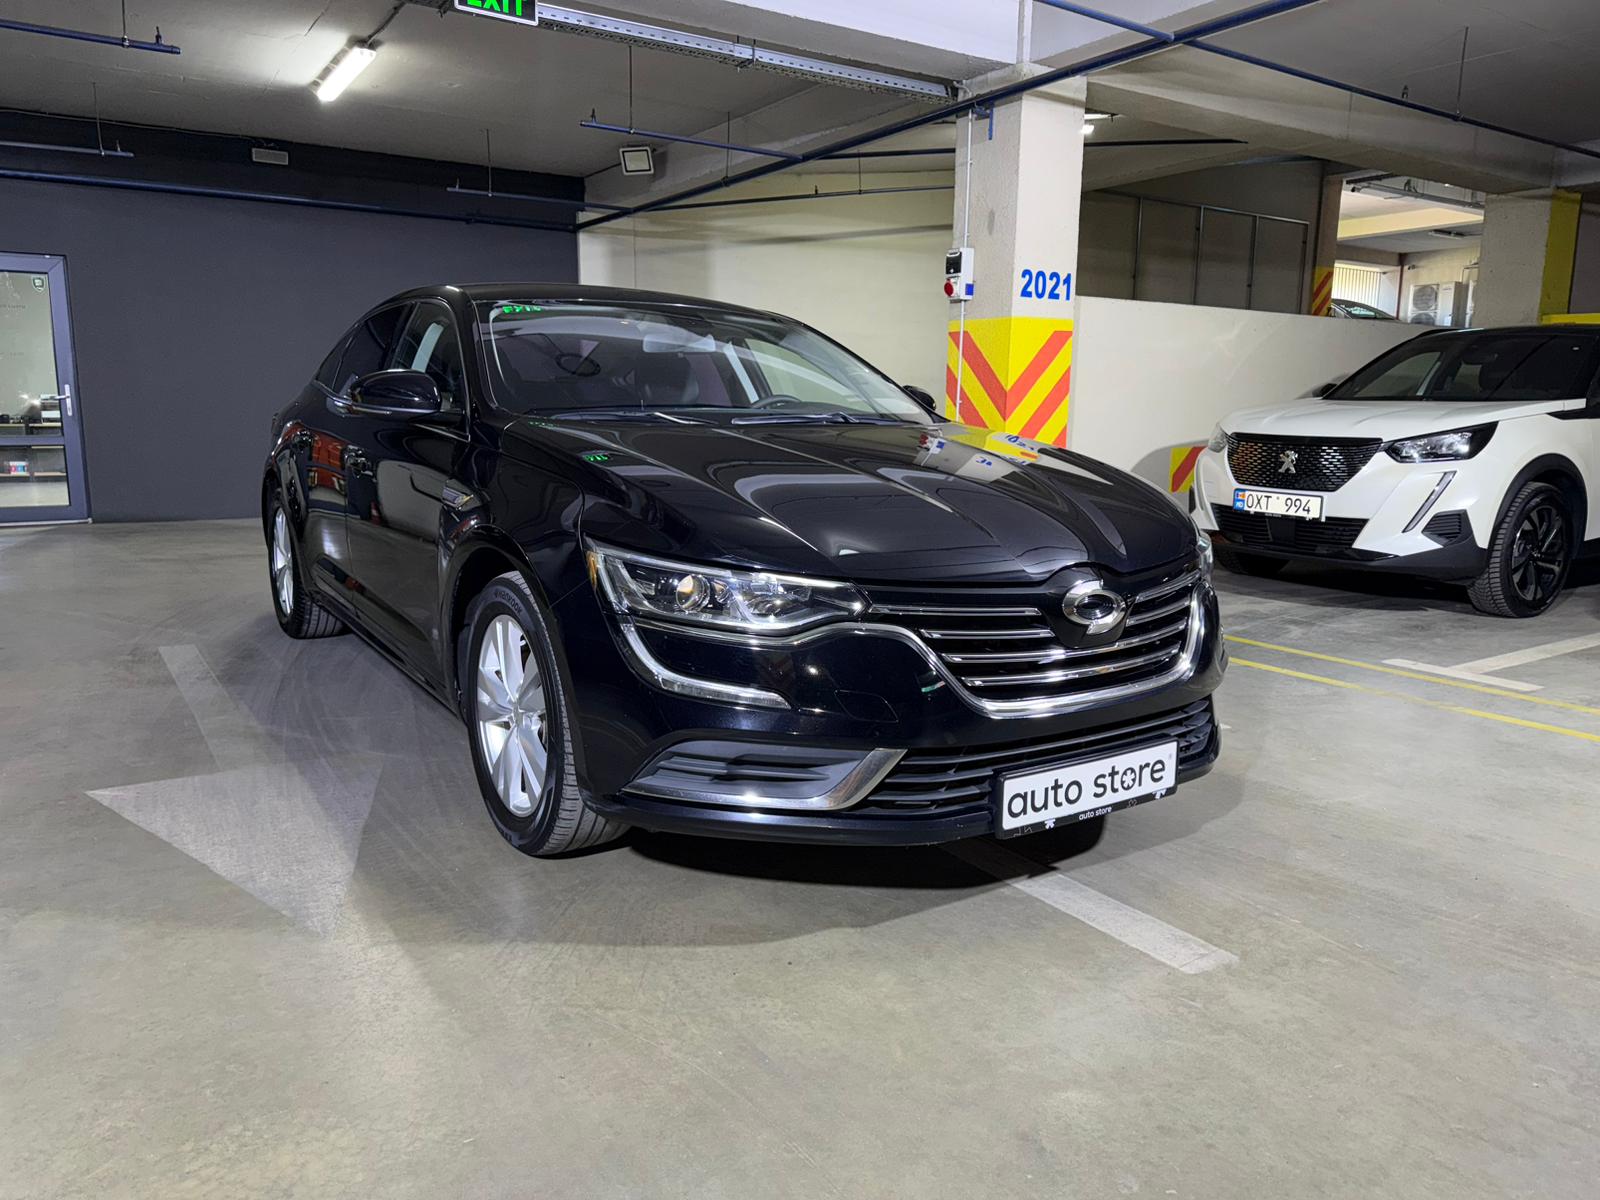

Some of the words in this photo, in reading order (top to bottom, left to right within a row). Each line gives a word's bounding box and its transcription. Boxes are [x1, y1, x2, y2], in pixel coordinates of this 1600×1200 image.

[467, 0, 524, 16] XIT
[1020, 269, 1072, 301] 2021
[1246, 493, 1273, 511] OXT
[1284, 497, 1311, 515] 994
[1007, 778, 1083, 818] auto
[1093, 759, 1166, 799] store
[1078, 811, 1095, 820] auto
[1095, 806, 1113, 816] store
